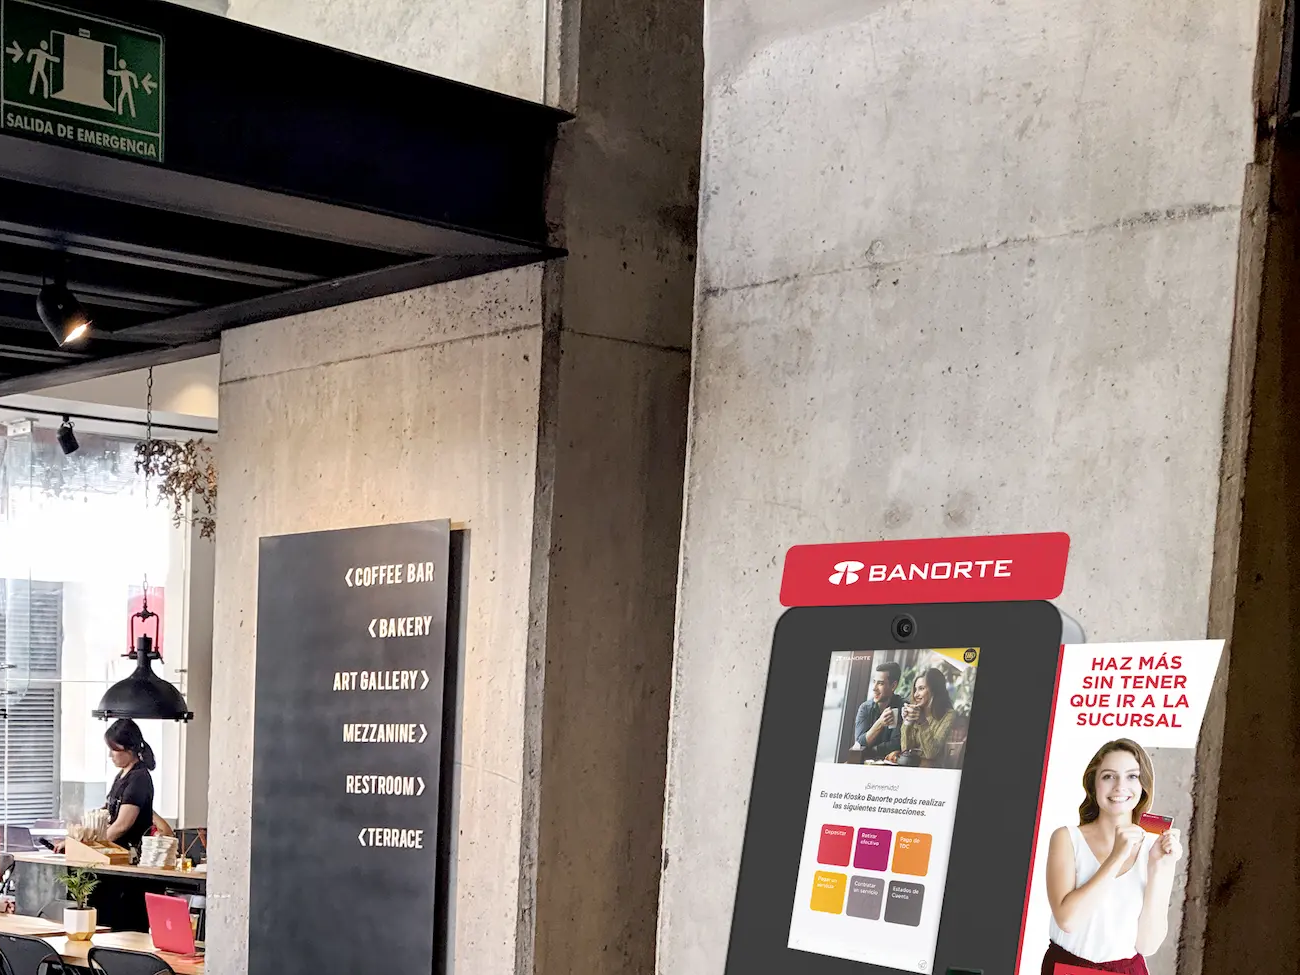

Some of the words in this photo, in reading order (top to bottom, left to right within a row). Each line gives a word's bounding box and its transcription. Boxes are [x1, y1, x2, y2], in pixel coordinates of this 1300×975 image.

[6, 112, 54, 135] SALIDA
[57, 124, 74, 139] DE
[77, 128, 157, 157] EMERGENCIA
[355, 564, 404, 587] COFFEE
[407, 561, 434, 583] BAR
[868, 559, 1013, 582] BANORTE
[379, 615, 432, 638] BAKERY
[1091, 657, 1133, 671] HAZ
[1138, 652, 1183, 670] MÁS
[333, 672, 358, 691] ART
[360, 670, 418, 690] GALLERY
[1082, 676, 1114, 689] SIN
[1120, 675, 1188, 689] TENER
[1070, 694, 1111, 708] QUE
[1116, 694, 1135, 708] IR
[1141, 695, 1156, 708] A
[1163, 694, 1190, 708] LA
[1076, 712, 1182, 728] SUCURSAL
[343, 723, 417, 743] MEZZANINE
[346, 775, 414, 796] RESTROOM
[843, 803, 876, 813] siguientes
[877, 806, 926, 816] transacciones.
[844, 793, 866, 801] Kiosko
[867, 794, 893, 803] Banorte
[893, 797, 917, 805] podrás
[918, 799, 945, 807] realizar
[368, 828, 424, 849] TERRACE
[860, 888, 879, 896] servicio
[892, 886, 912, 894] Estados
